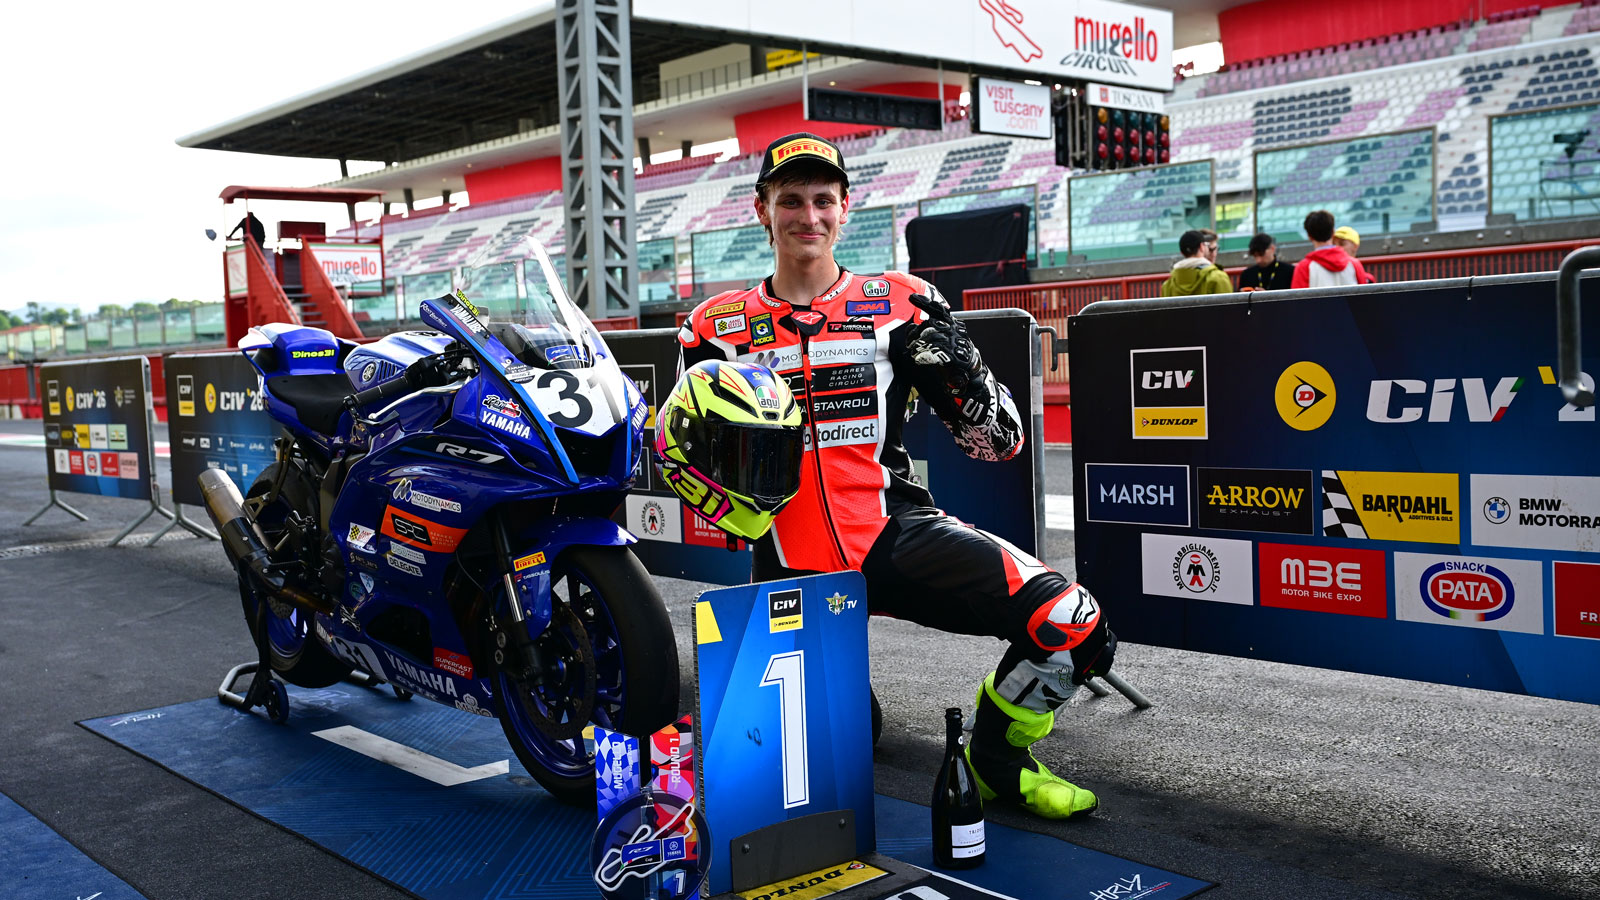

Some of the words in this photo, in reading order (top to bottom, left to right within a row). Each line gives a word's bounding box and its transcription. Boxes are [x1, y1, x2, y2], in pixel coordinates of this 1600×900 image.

[1075, 16, 1158, 62] mugello
[1060, 52, 1137, 76] CIRCUIT
[994, 100, 1045, 118] tuscany
[1006, 117, 1039, 130] .com
[778, 142, 832, 160] PIRELLI
[322, 256, 377, 275] mugello
[709, 304, 742, 315] PIRELLI
[855, 303, 885, 311] DNA
[832, 367, 865, 375] SERRES
[1141, 370, 1196, 389] CIV
[828, 379, 865, 387] CIRCUIT
[220, 391, 245, 411] CIV
[1366, 376, 1526, 423] CIV
[482, 411, 531, 439] YAMAHA
[1150, 418, 1198, 426] DUNLOP
[804, 423, 875, 445] otodirect
[436, 442, 504, 465] R7
[412, 491, 462, 512] MOTODYNAMICS
[1100, 483, 1174, 506] MARSH
[1206, 485, 1305, 509] ARROW
[1219, 508, 1292, 516] EXHAUST
[1362, 494, 1453, 523] BARDAHL
[1519, 498, 1562, 512] BMW
[1519, 513, 1600, 529] MOTORRA
[515, 553, 544, 569] PIRELLI
[1173, 543, 1221, 594] MOTOABBIGLIAMENTO.IT
[1446, 561, 1486, 573] SNACK
[1281, 588, 1310, 597] MOTOR
[1313, 591, 1333, 599] BIKE
[1336, 593, 1362, 602] EXPO
[1438, 579, 1495, 603] PATA
[773, 599, 797, 611] CIV
[1580, 611, 1600, 622] FR
[384, 650, 458, 698] YAMAHA
[435, 656, 473, 673] SUPERFAST
[440, 663, 466, 677] FERRIES
[759, 650, 810, 810] 1
[612, 741, 624, 789] MUGELLO
[670, 746, 681, 783] ROUND
[675, 871, 685, 895] 1
[752, 868, 844, 900] DUNLO
